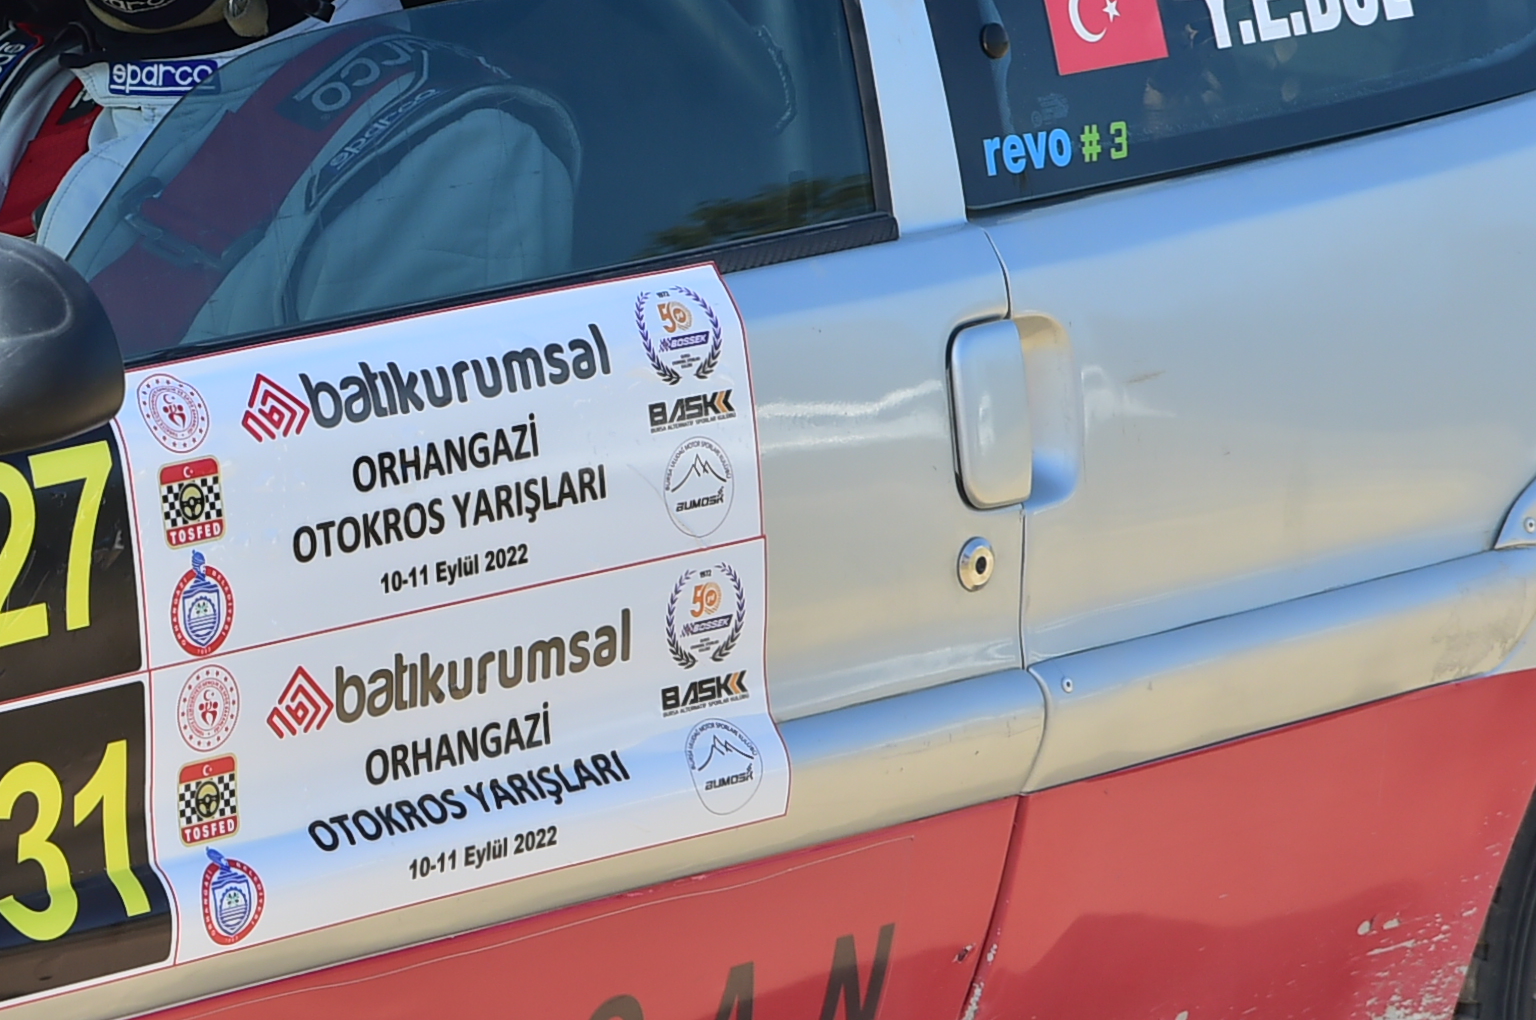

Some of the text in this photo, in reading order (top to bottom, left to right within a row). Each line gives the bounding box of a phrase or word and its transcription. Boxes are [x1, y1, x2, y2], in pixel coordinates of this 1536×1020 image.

[113, 63, 213, 94] sparco
[982, 128, 1073, 177] revo
[353, 412, 539, 493] ORHANGAZİ
[170, 522, 221, 545] TOSFED
[293, 464, 607, 563] OTOKROS YARIŞLARI
[380, 543, 528, 593] 10-11 Eylül 2022
[366, 701, 551, 785] ORHANGAZİ
[308, 750, 630, 852] OTOKROS YARIŞLARI
[184, 818, 235, 842] TOSFED
[409, 826, 558, 880] 10-11 Eylül 2022
